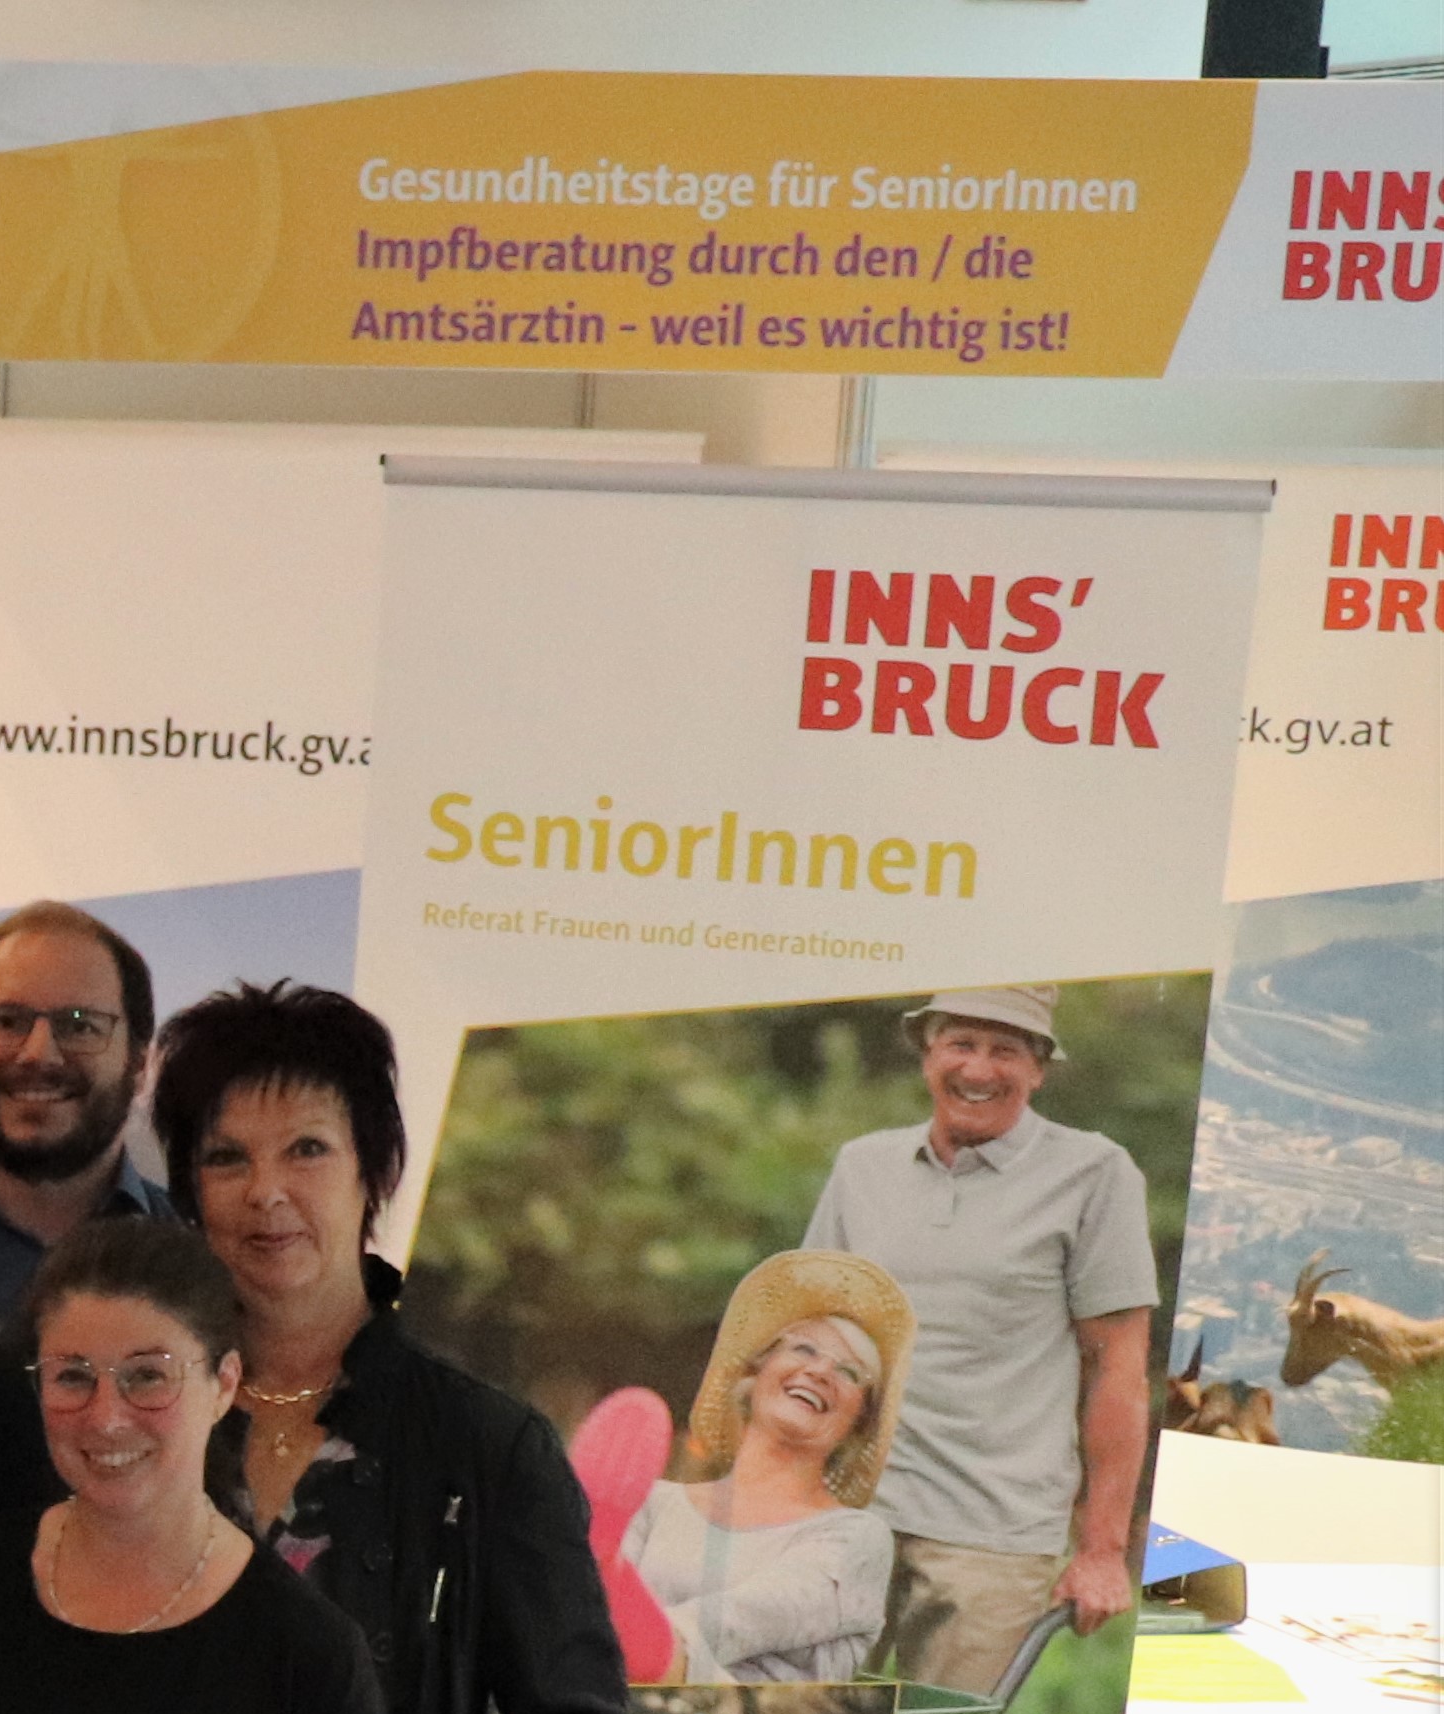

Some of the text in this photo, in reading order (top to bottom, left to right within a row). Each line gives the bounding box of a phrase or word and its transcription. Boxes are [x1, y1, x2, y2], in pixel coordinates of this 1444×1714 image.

[358, 156, 1138, 220] Gesundheitstage für SeniorInnen
[1289, 170, 1444, 232] INN
[357, 225, 1034, 287] Impfberatung durch den / die
[351, 300, 605, 343] Amtsärztin
[651, 303, 745, 347] weil
[758, 315, 806, 348] es
[821, 306, 986, 363] wichtig
[1000, 307, 1070, 351] ist!
[1324, 577, 1444, 633] BR
[798, 656, 1166, 750] BRUCK
[1239, 706, 1394, 755] k.gv.at
[426, 791, 979, 899] SeniorInnen
[423, 901, 905, 963] Referat Frauen und Generationen
